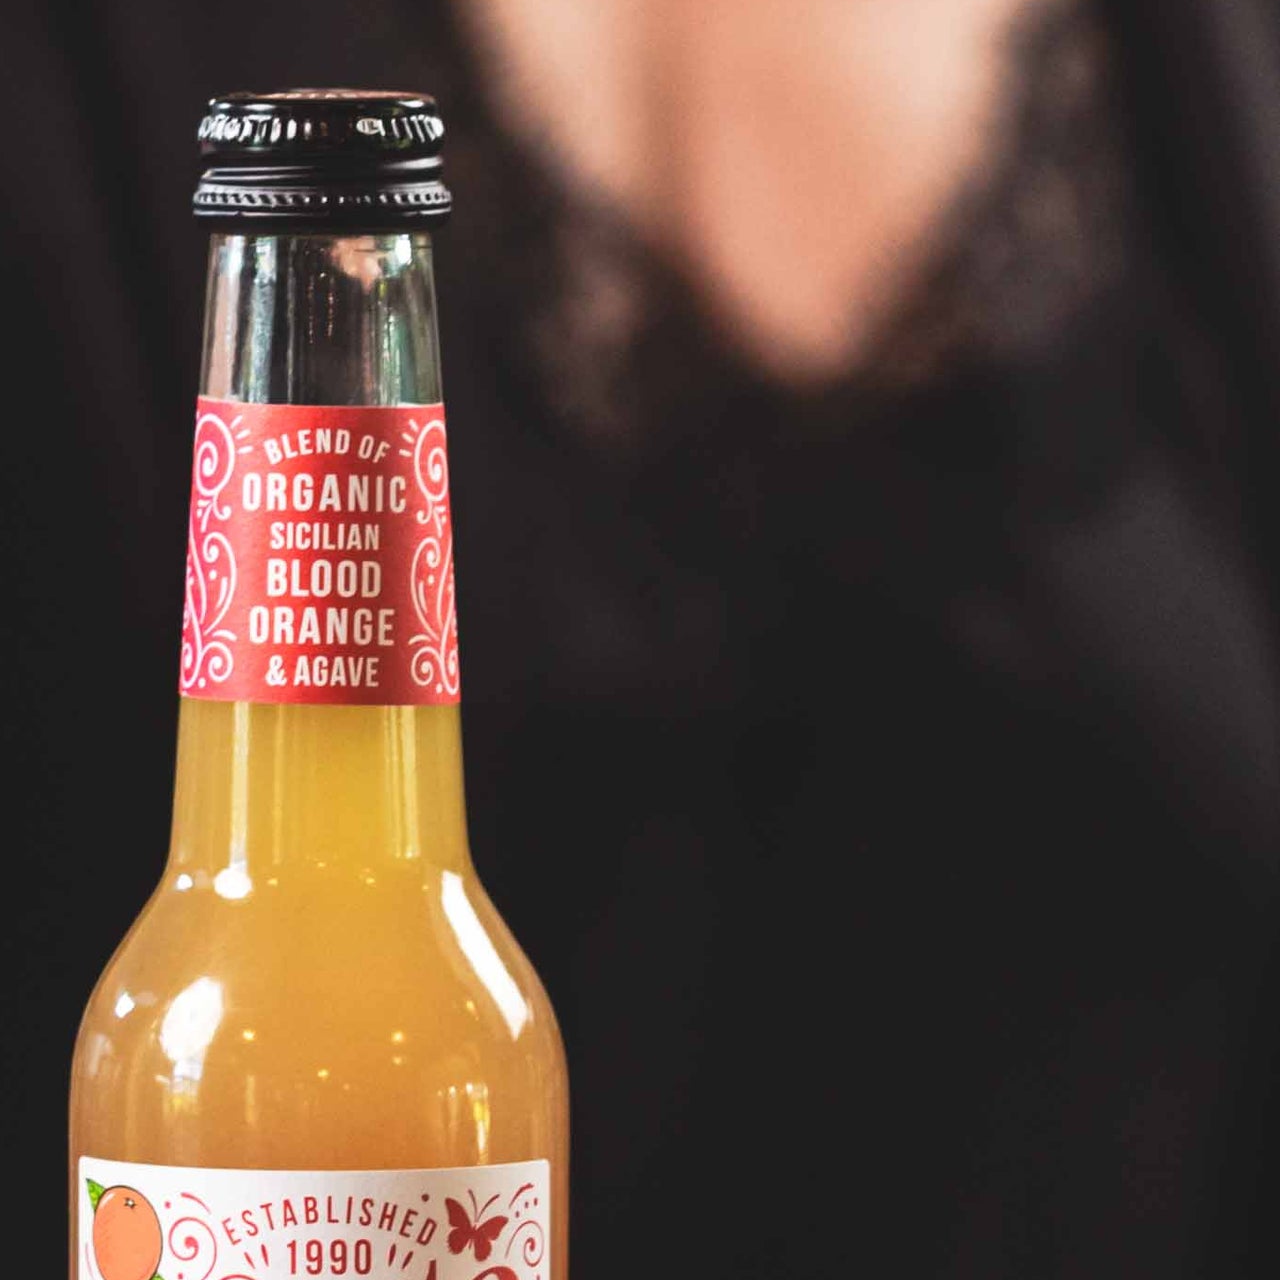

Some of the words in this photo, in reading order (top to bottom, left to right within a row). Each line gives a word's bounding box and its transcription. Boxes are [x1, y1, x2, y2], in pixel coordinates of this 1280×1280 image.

[264, 427, 350, 465] BLEND
[358, 434, 391, 464] OF
[242, 473, 407, 514] ORGANIC
[270, 522, 380, 551] SICILIAN
[266, 559, 382, 598] BLOOD
[249, 607, 395, 647] ORANGE
[266, 655, 286, 687] &
[293, 656, 379, 687] AGAVE
[221, 1196, 438, 1247] ESTABLISHED
[286, 1238, 373, 1275] 1990
